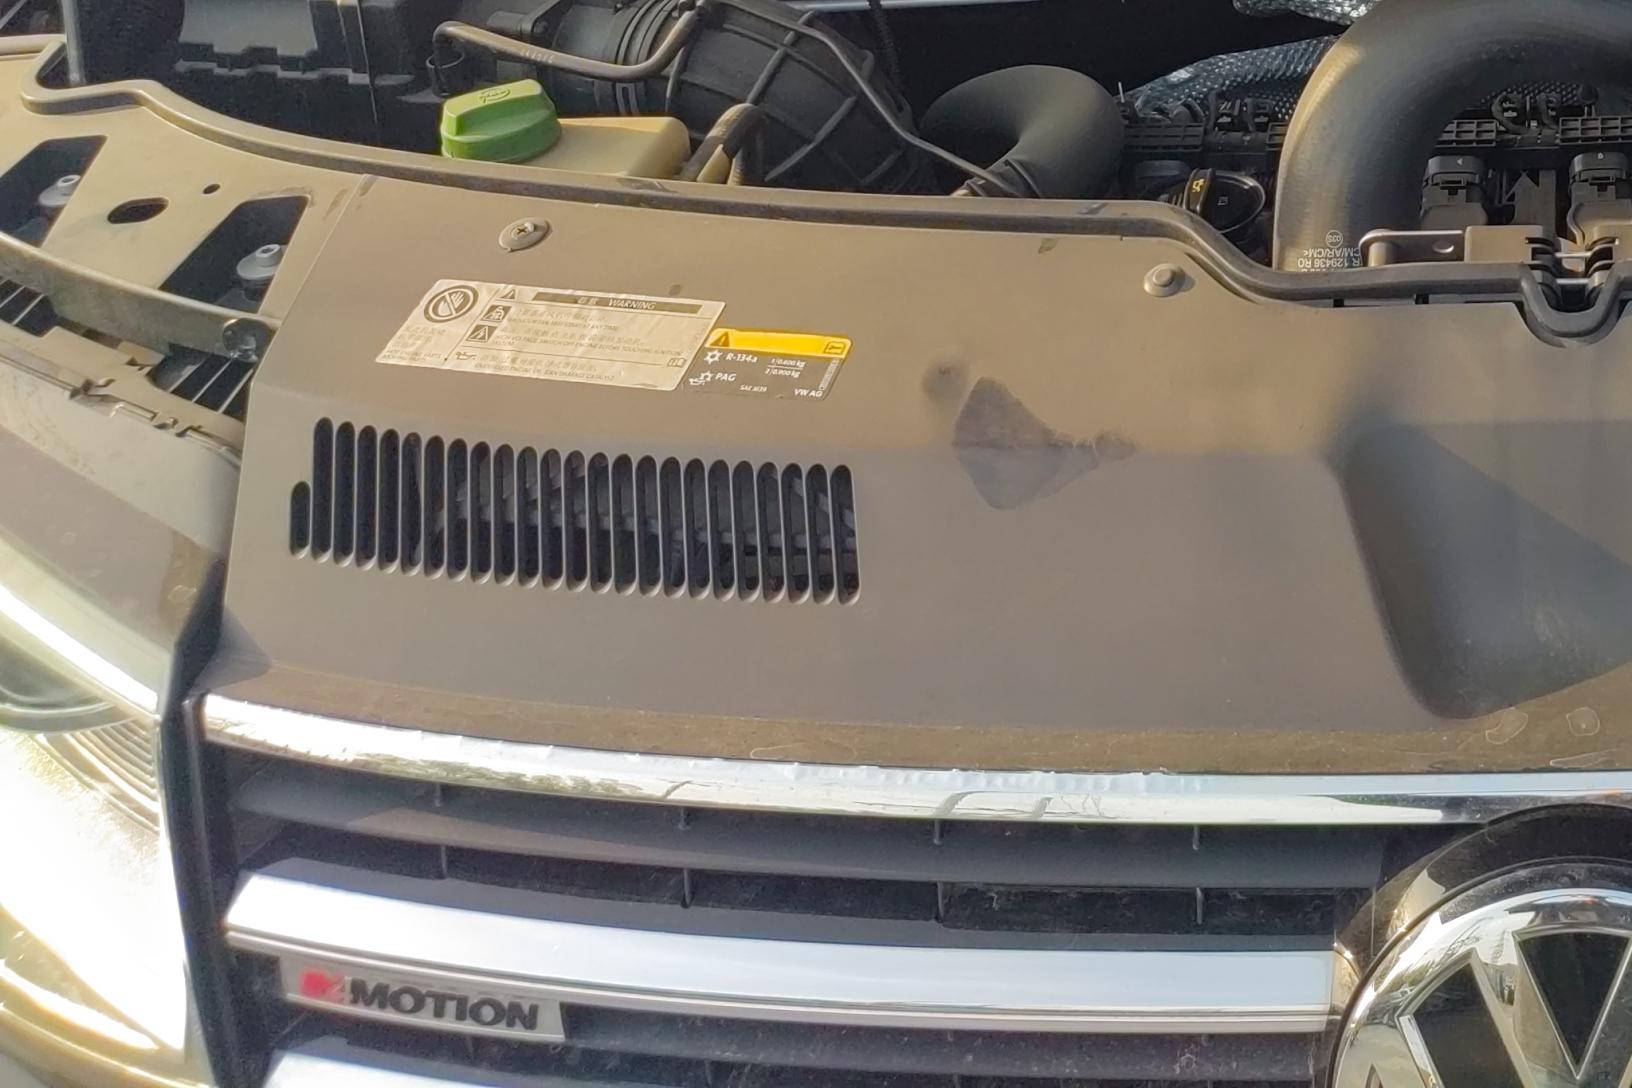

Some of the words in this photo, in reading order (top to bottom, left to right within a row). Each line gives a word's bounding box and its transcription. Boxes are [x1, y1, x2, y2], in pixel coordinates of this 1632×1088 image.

[608, 298, 656, 310] WARNING
[725, 352, 758, 363] R-134a
[715, 372, 736, 382] PAG
[794, 388, 808, 397] VW
[808, 389, 823, 398] AG
